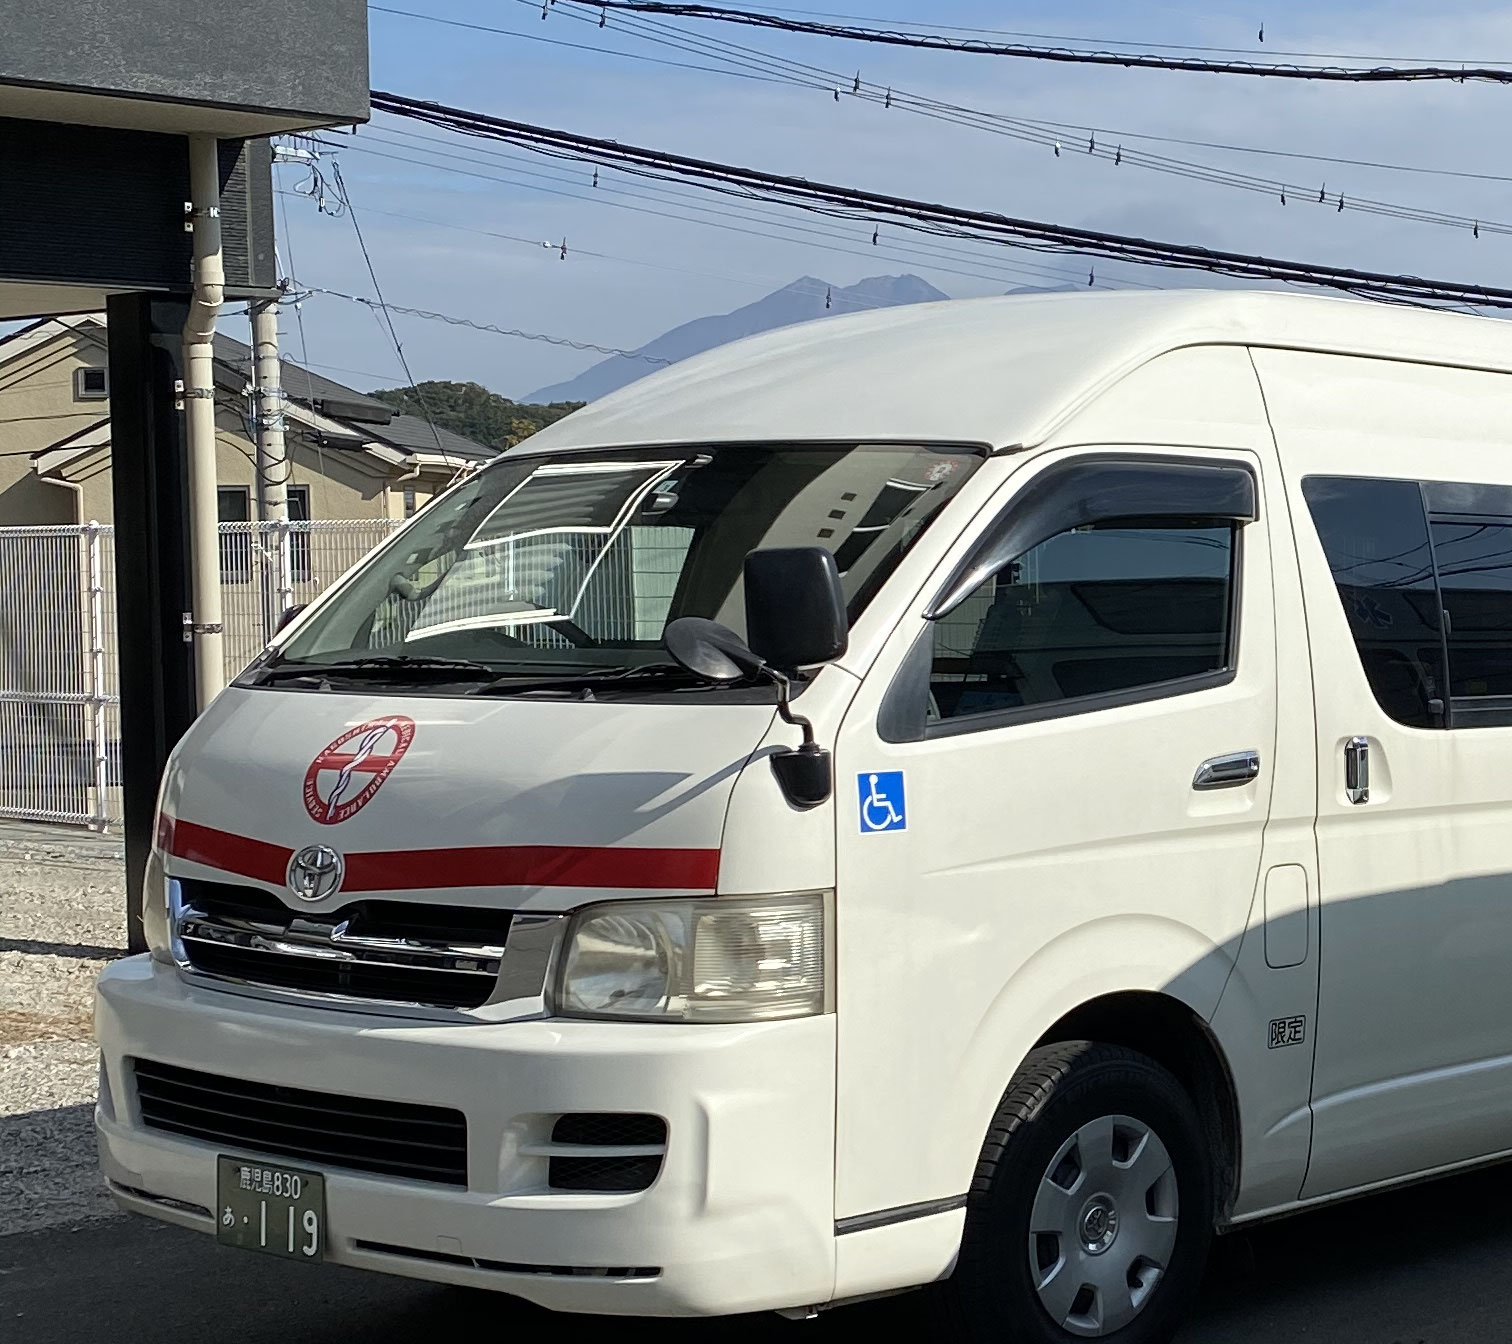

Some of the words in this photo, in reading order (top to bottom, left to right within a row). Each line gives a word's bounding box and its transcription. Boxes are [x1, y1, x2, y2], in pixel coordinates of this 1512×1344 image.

[305, 777, 324, 818] SERVICE
[337, 759, 397, 821] AMBULANCE
[1270, 1017, 1303, 1047] 限定
[222, 1205, 236, 1228] あ
